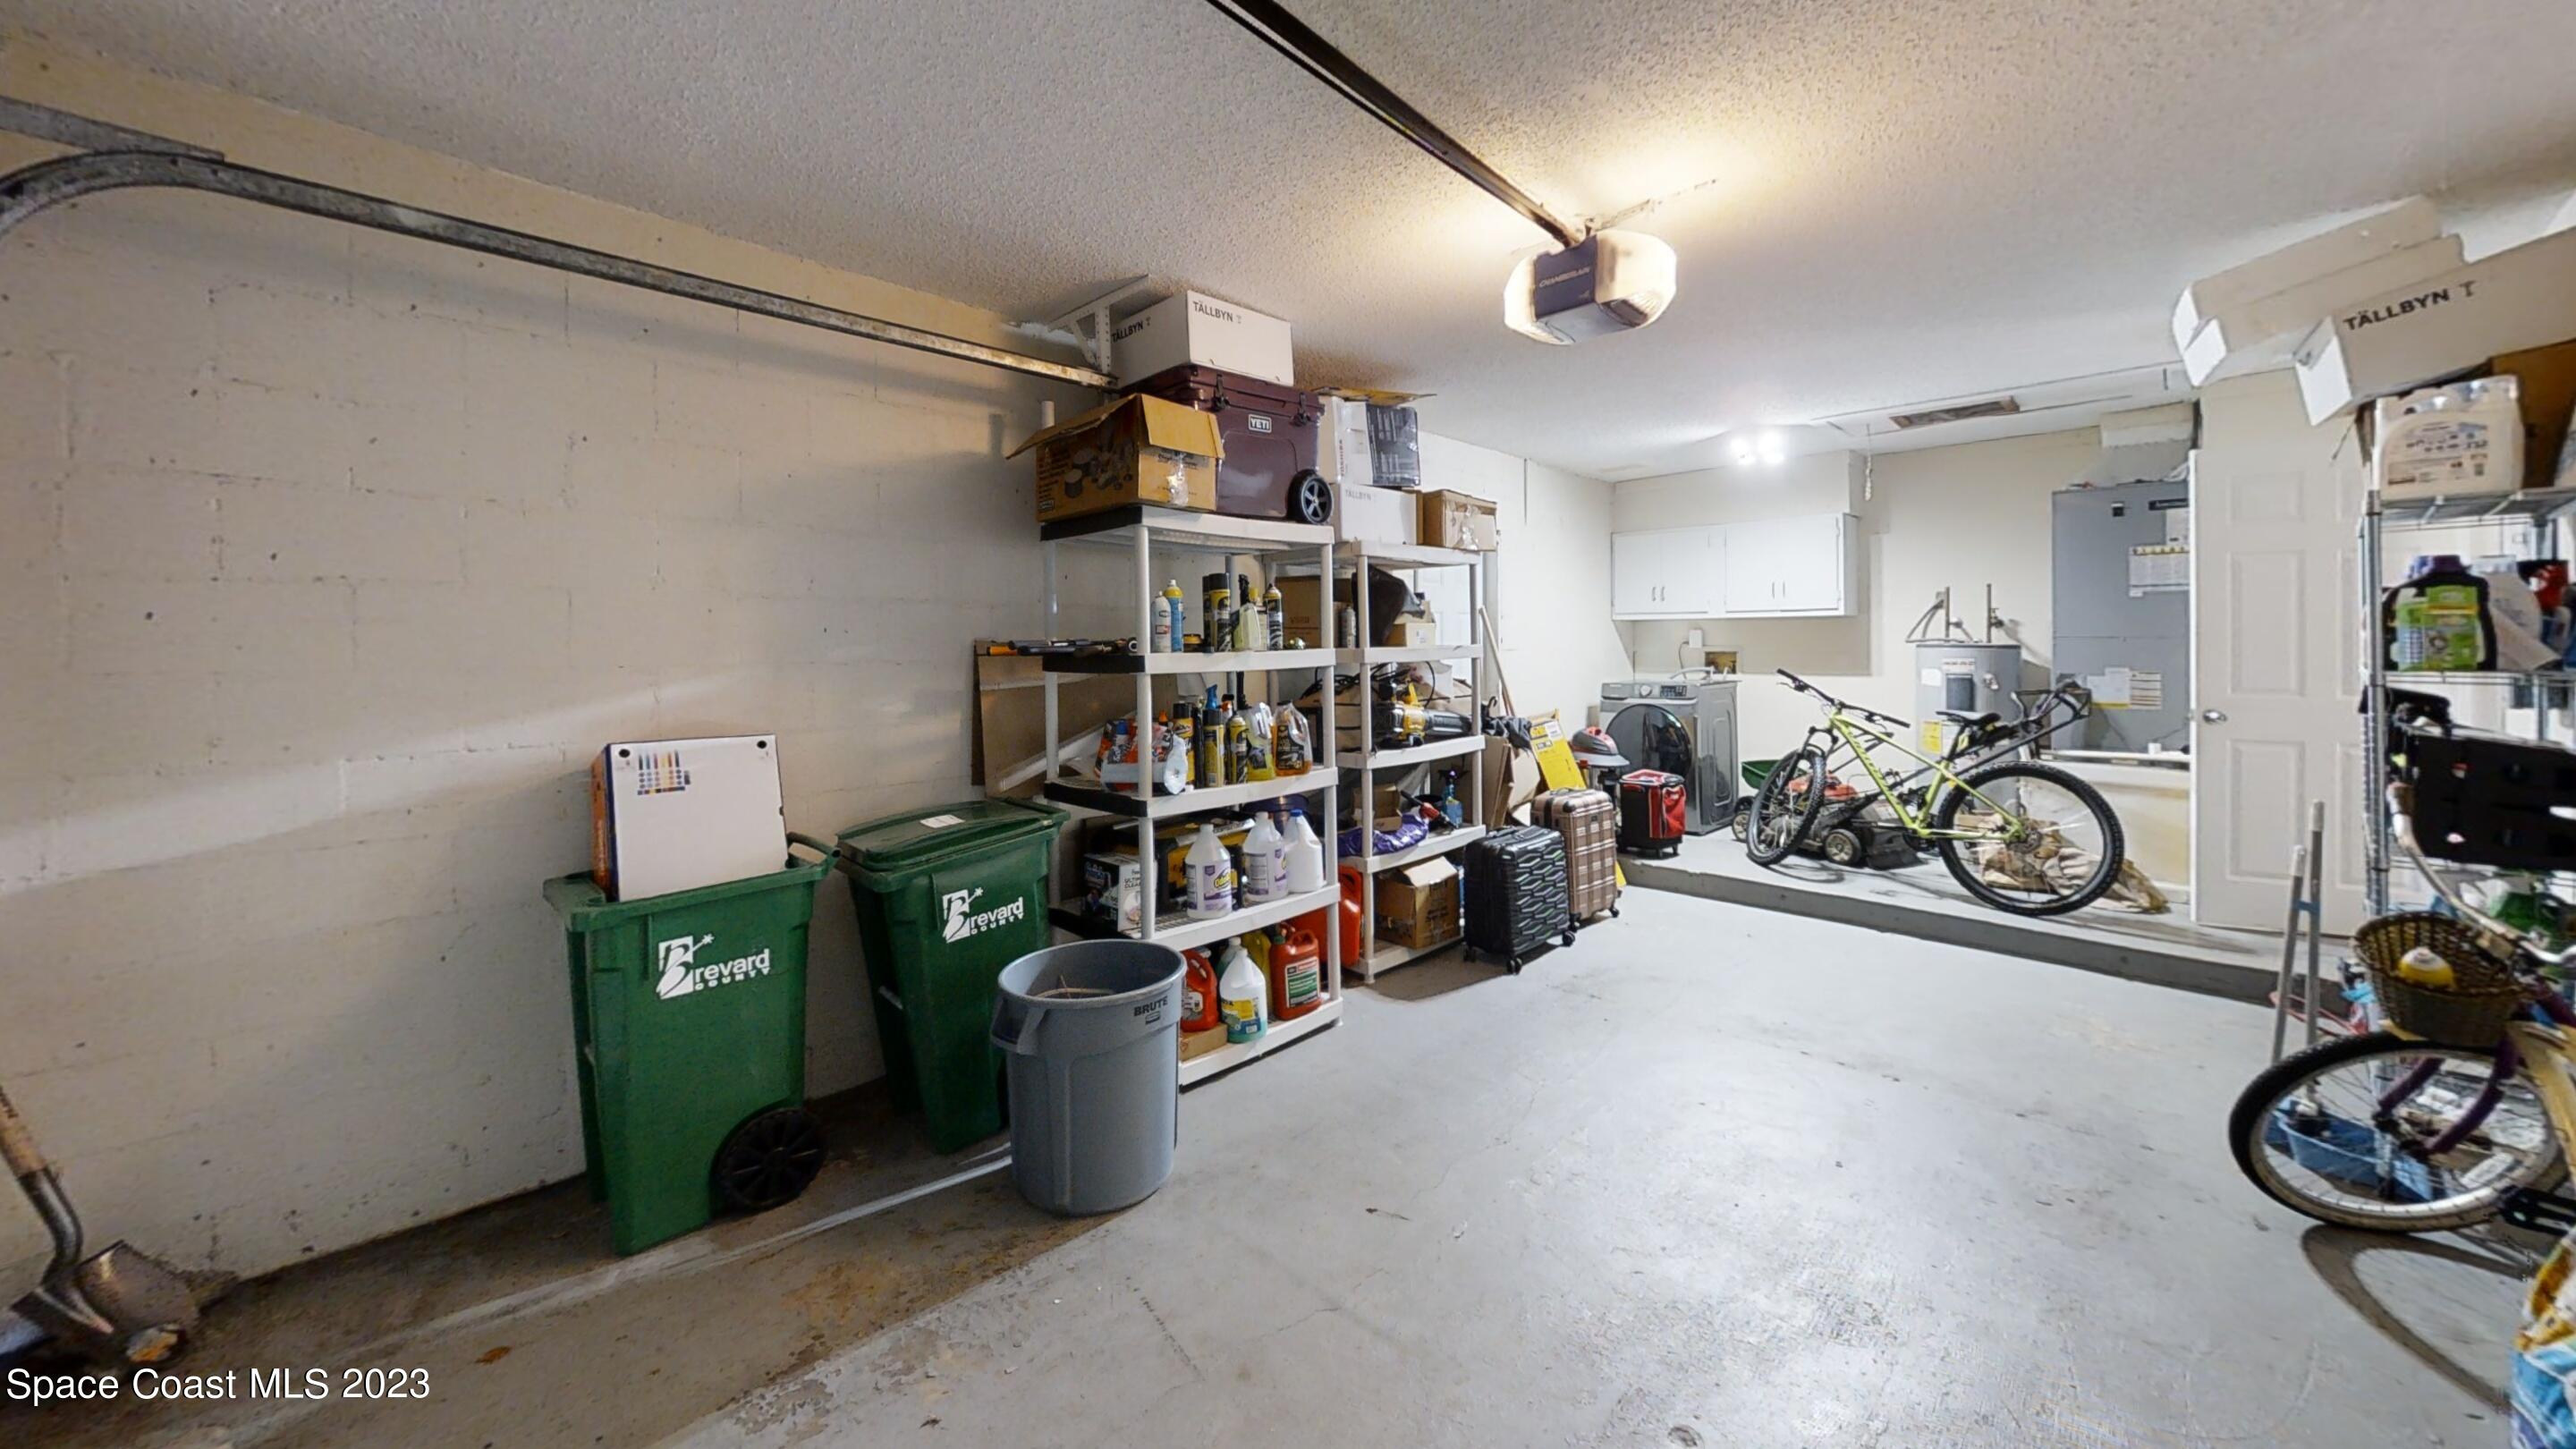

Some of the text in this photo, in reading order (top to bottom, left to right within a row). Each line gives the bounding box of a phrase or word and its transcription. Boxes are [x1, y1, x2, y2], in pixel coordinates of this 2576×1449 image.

[2343, 288, 2450, 331] TÄLLBYN
[1251, 418, 1269, 430] YETI
[1133, 995, 1168, 1017] BRUTE
